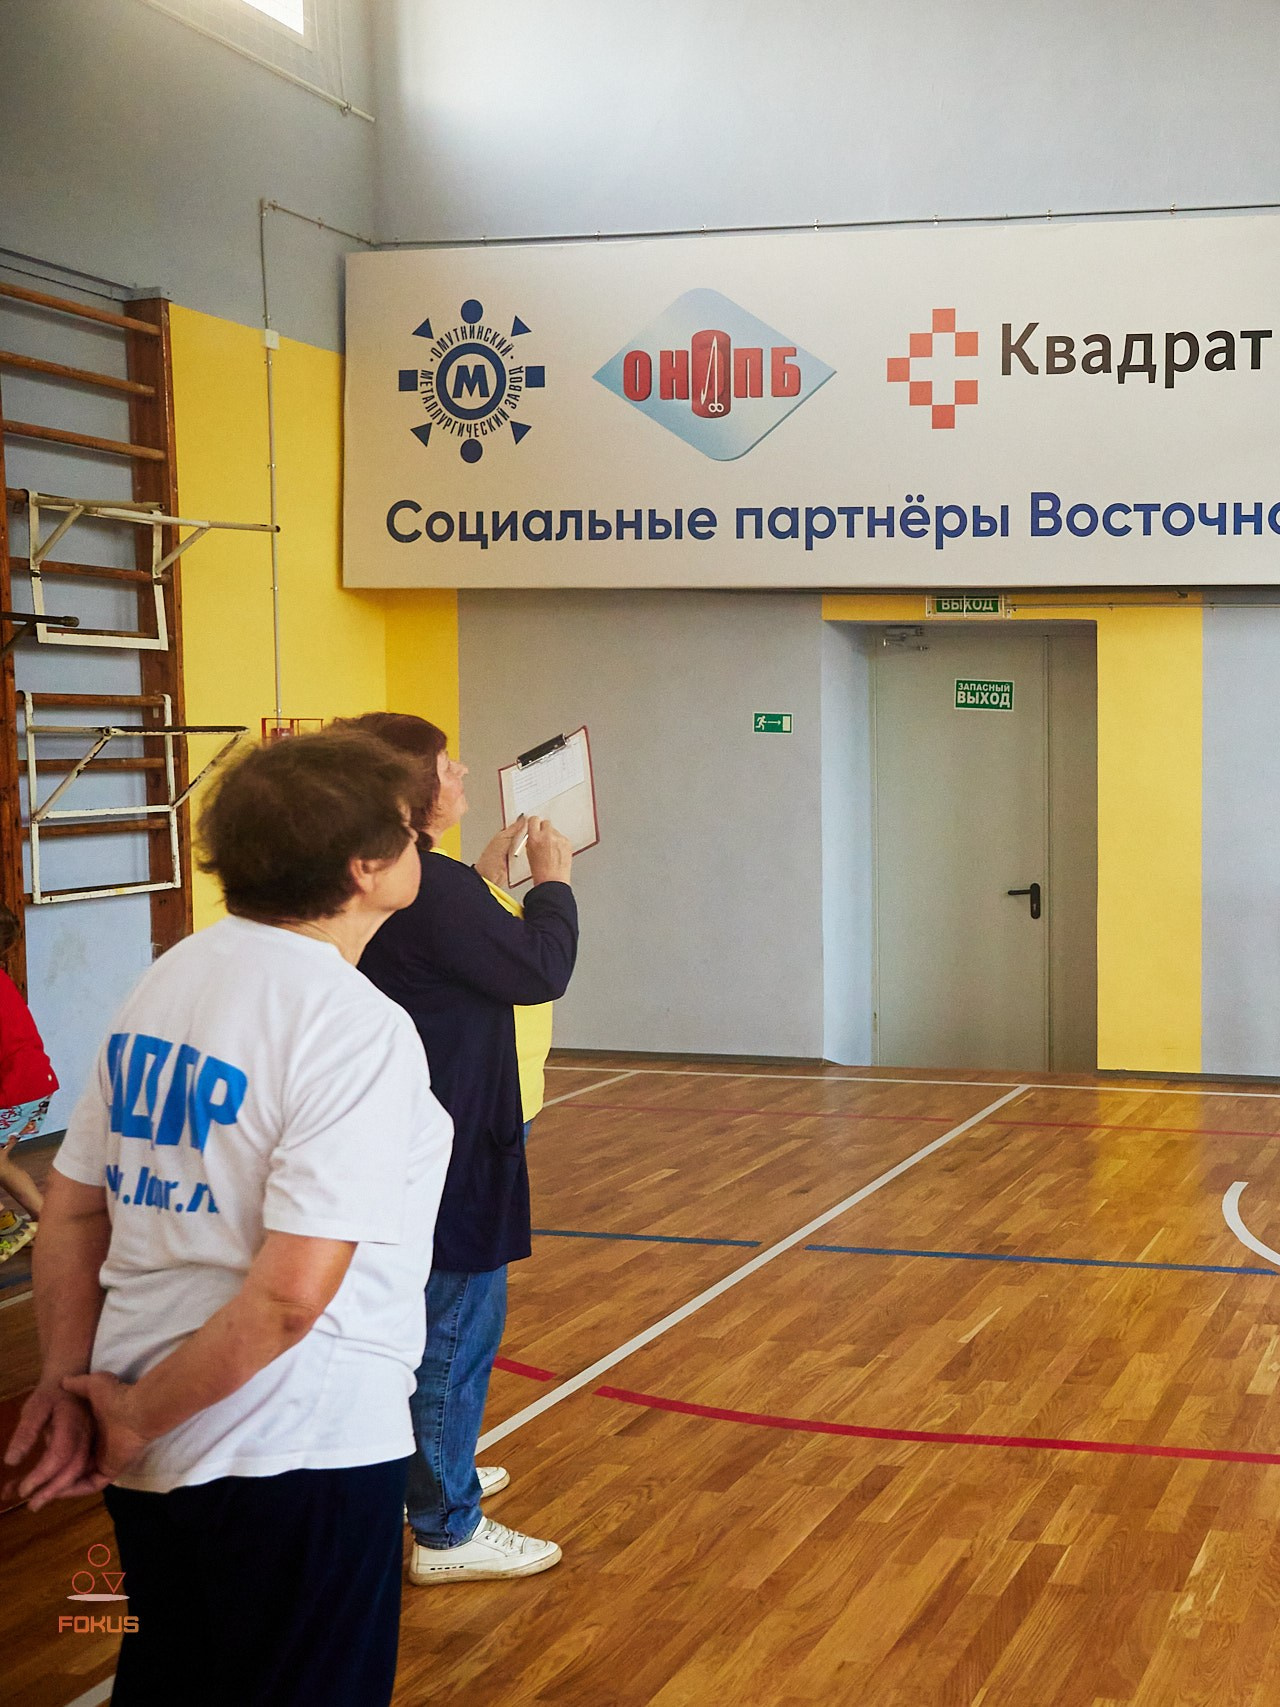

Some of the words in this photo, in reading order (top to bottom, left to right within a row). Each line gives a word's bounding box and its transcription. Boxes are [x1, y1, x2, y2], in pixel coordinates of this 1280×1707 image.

[430, 325, 515, 359] ОМУТНИНСКИЙ
[420, 369, 510, 438] МЕТАЛЛУРГИЧЕСКИЙ
[504, 365, 524, 409] ЗАВОД
[386, 499, 718, 550] Социальные
[735, 494, 1009, 550] партнёры
[957, 691, 1011, 708] ВЫХОД
[958, 683, 1010, 693] ЗАПАСНЫЙ
